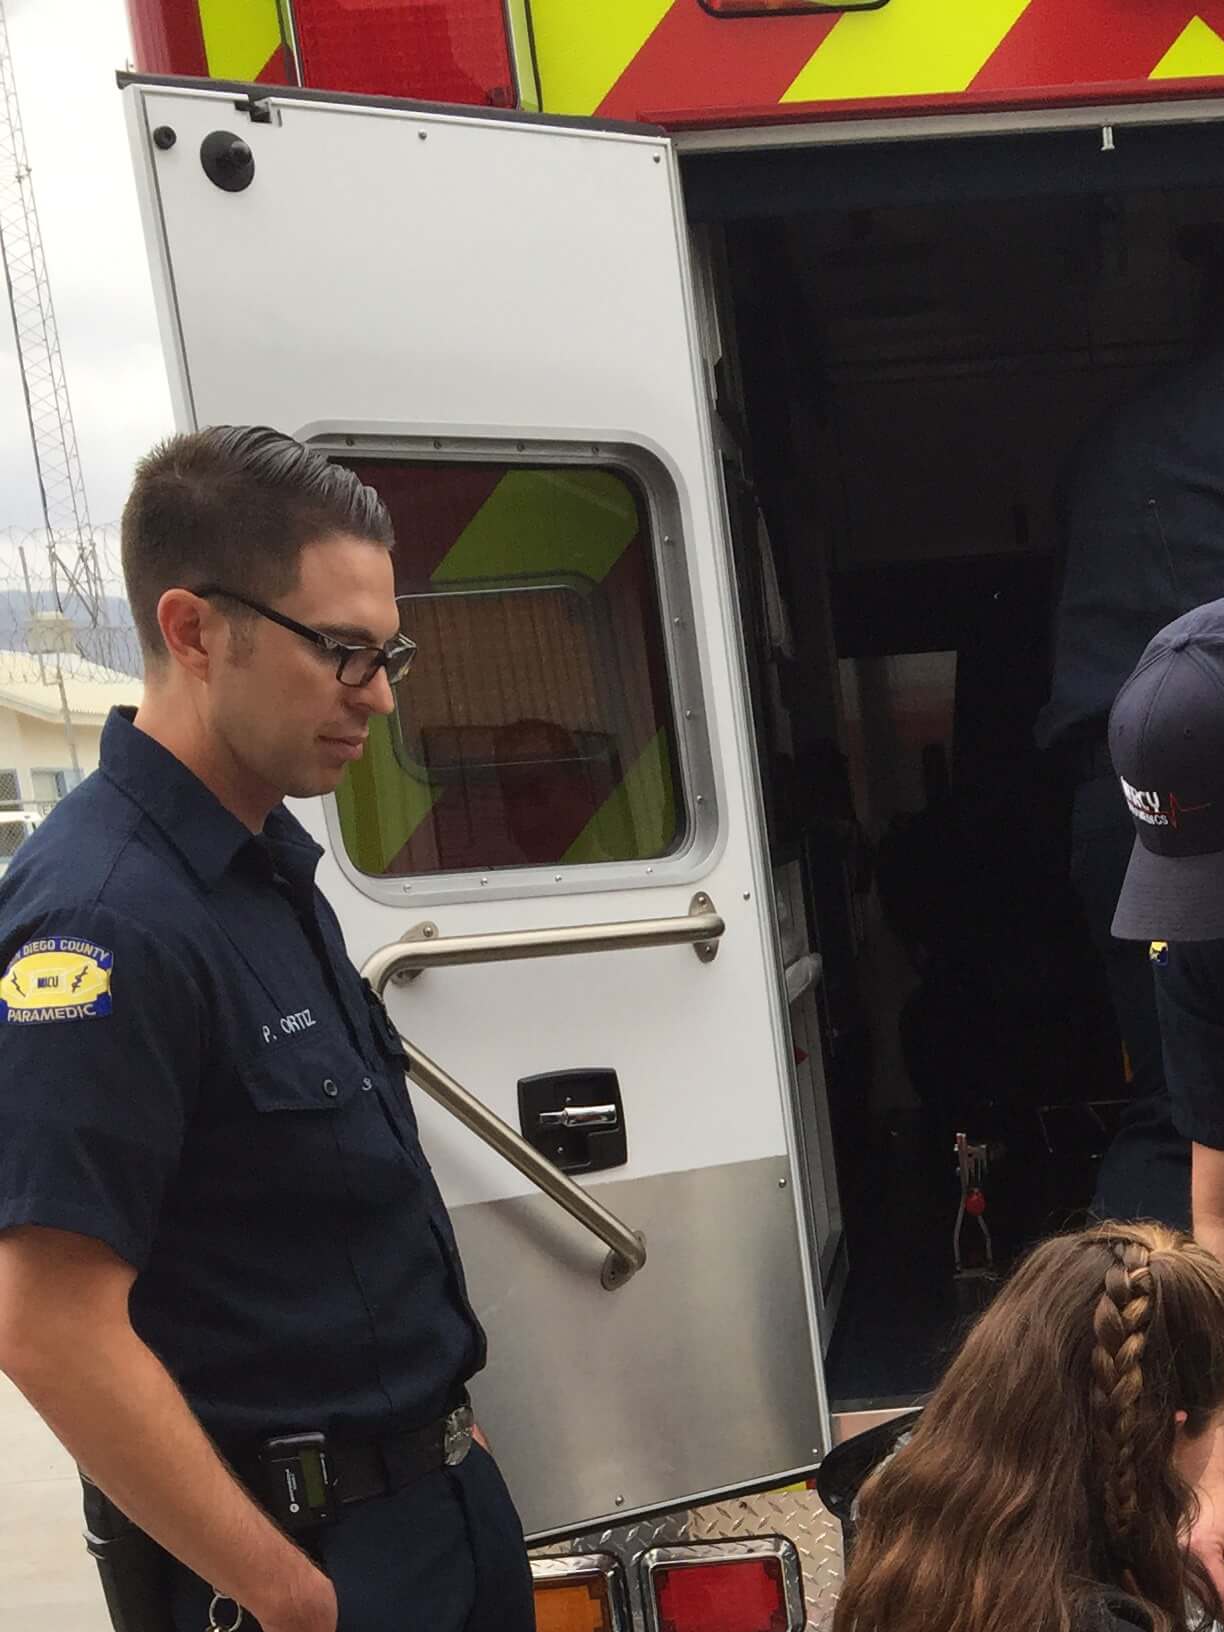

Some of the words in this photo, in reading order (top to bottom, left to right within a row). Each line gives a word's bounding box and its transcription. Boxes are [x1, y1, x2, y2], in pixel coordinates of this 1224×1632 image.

[23, 939, 56, 956] DIEGO
[60, 939, 110, 961] COUNTY
[7, 1003, 97, 1023] PARAMEDIC
[262, 1025, 278, 1043] P.
[280, 1008, 317, 1034] ORTIZ
